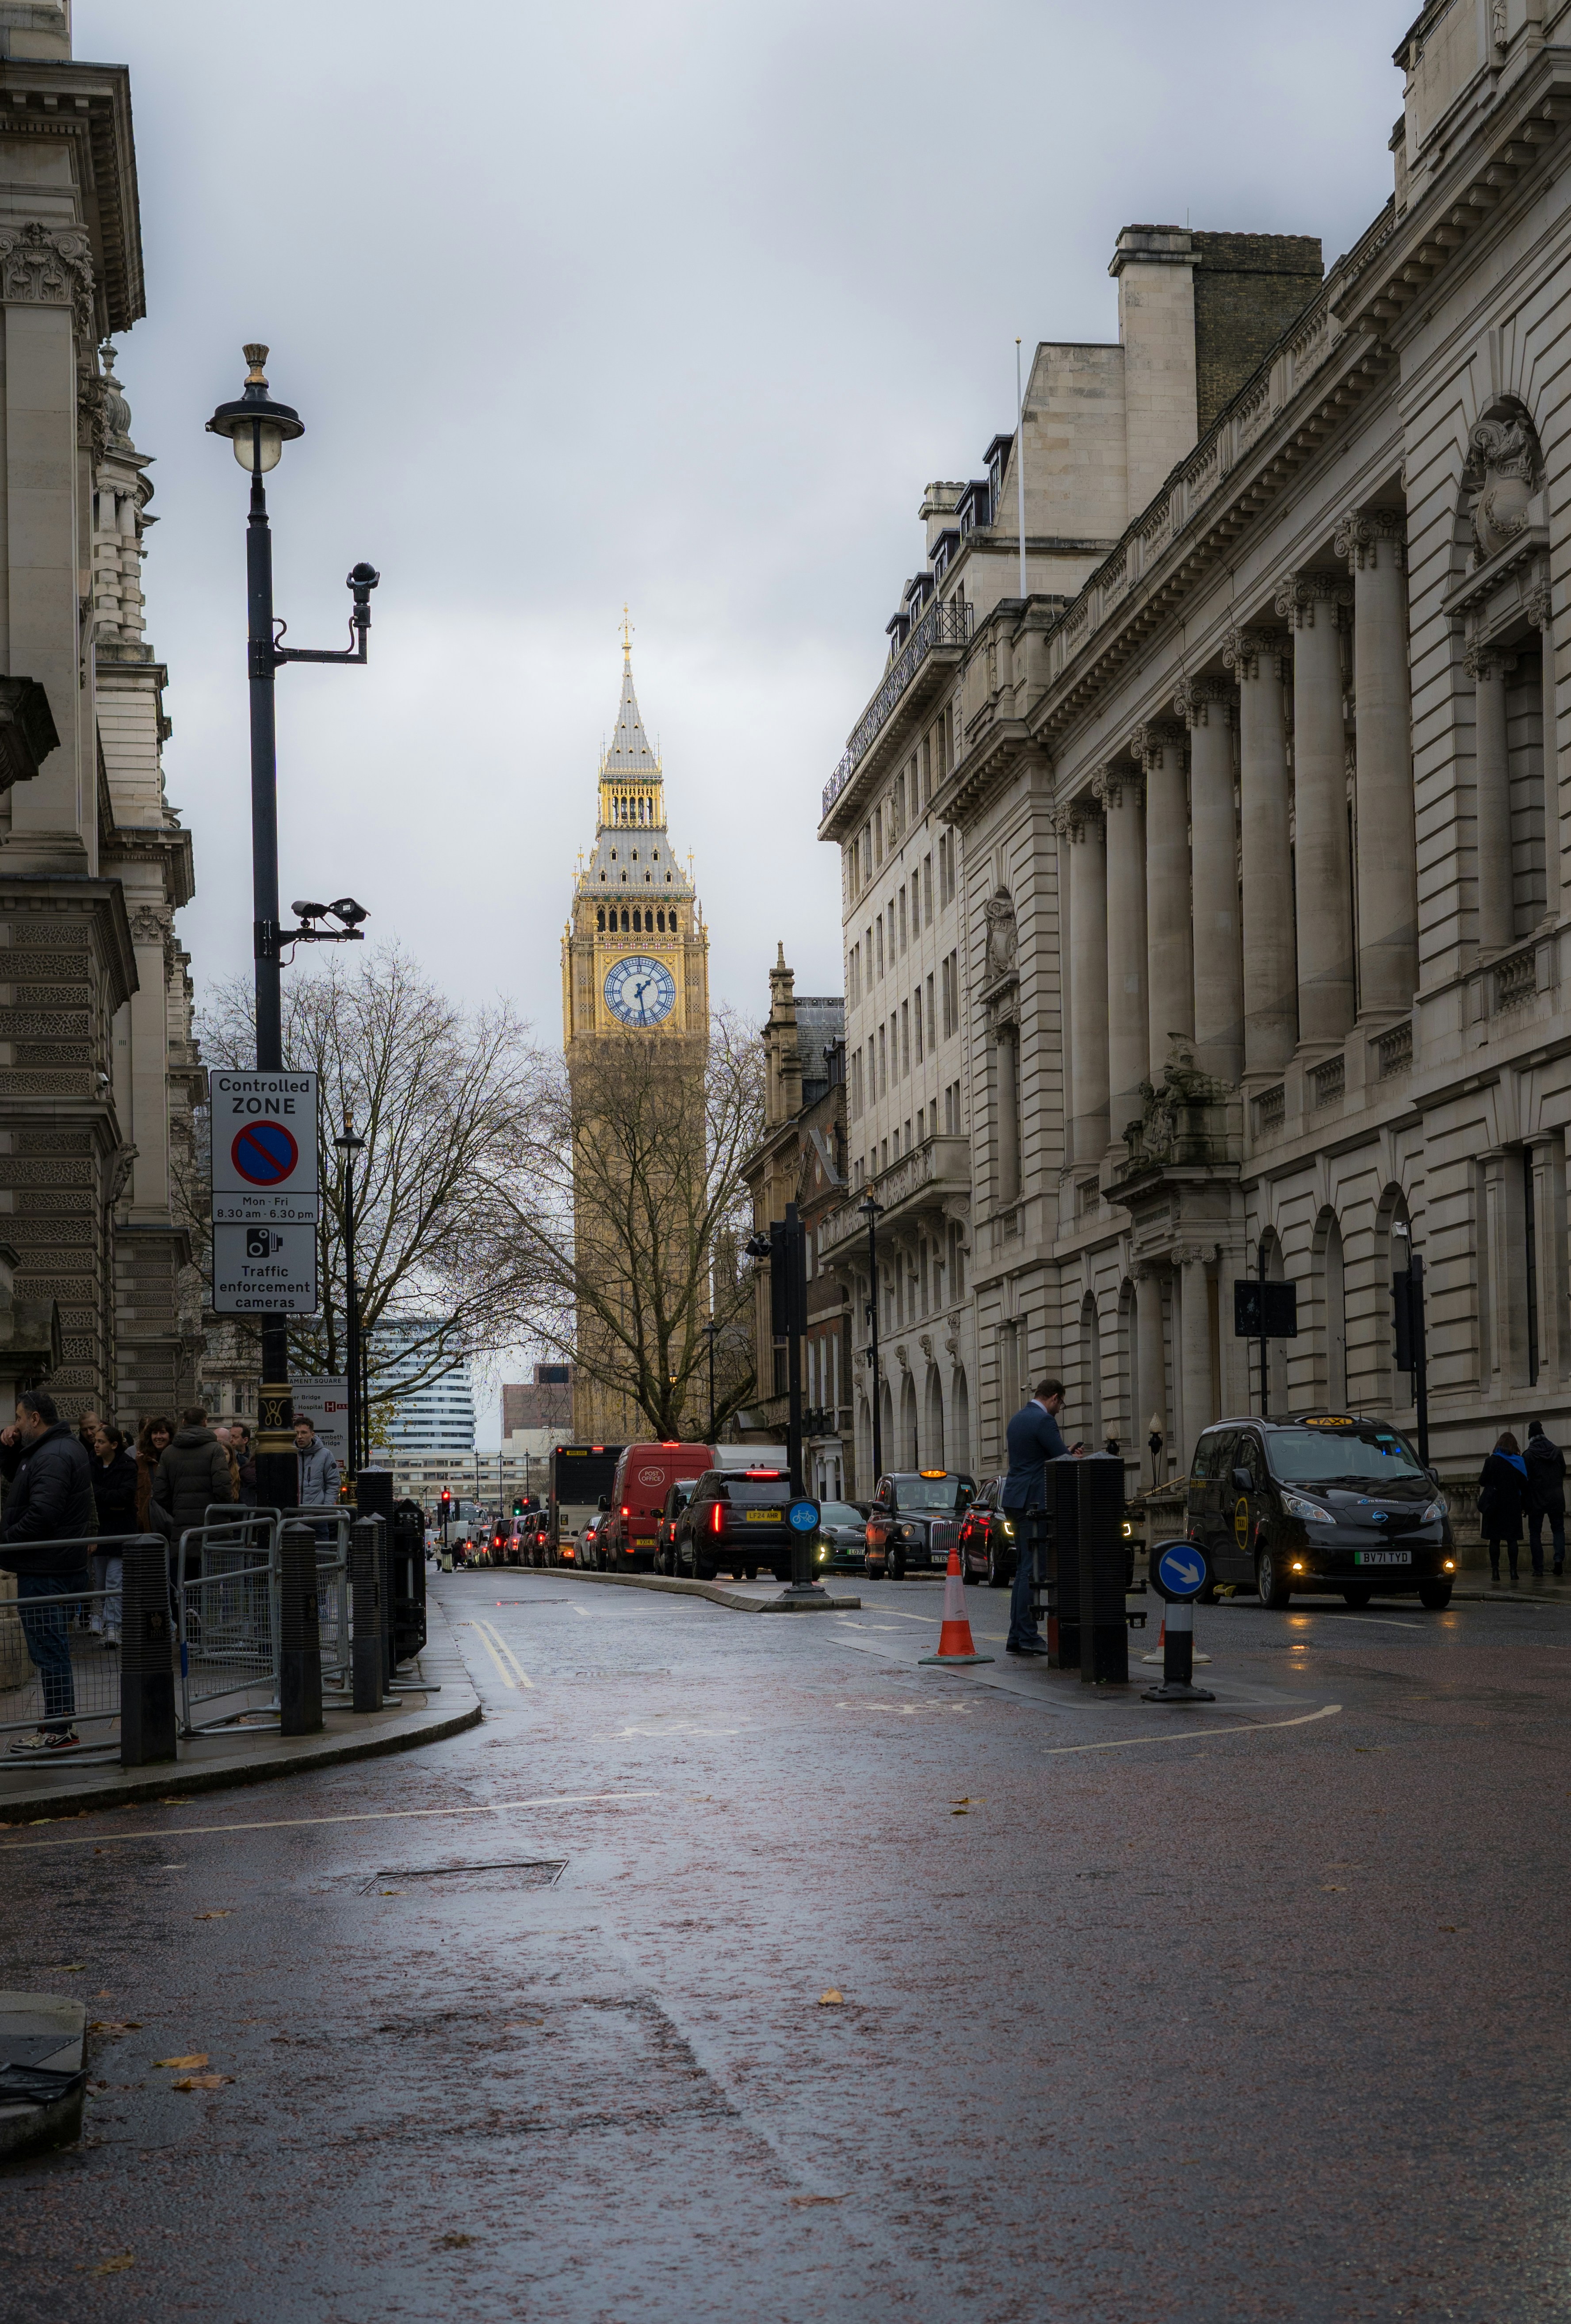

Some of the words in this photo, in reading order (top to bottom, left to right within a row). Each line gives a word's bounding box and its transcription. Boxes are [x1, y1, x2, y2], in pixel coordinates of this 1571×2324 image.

[219, 1078, 309, 1093] Controlled
[232, 1097, 295, 1114] ZONE
[243, 1197, 265, 1206] Mon
[275, 1197, 288, 1206] Fri
[217, 1209, 243, 1218] 8.30
[270, 1209, 295, 1218] 6.30
[298, 1212, 313, 1220] pm
[241, 1265, 288, 1277] Traffic
[219, 1281, 310, 1292] enforcement
[235, 1299, 295, 1308] cameras
[1364, 1553, 1386, 1562] BV71
[1388, 1553, 1407, 1562] TYD
